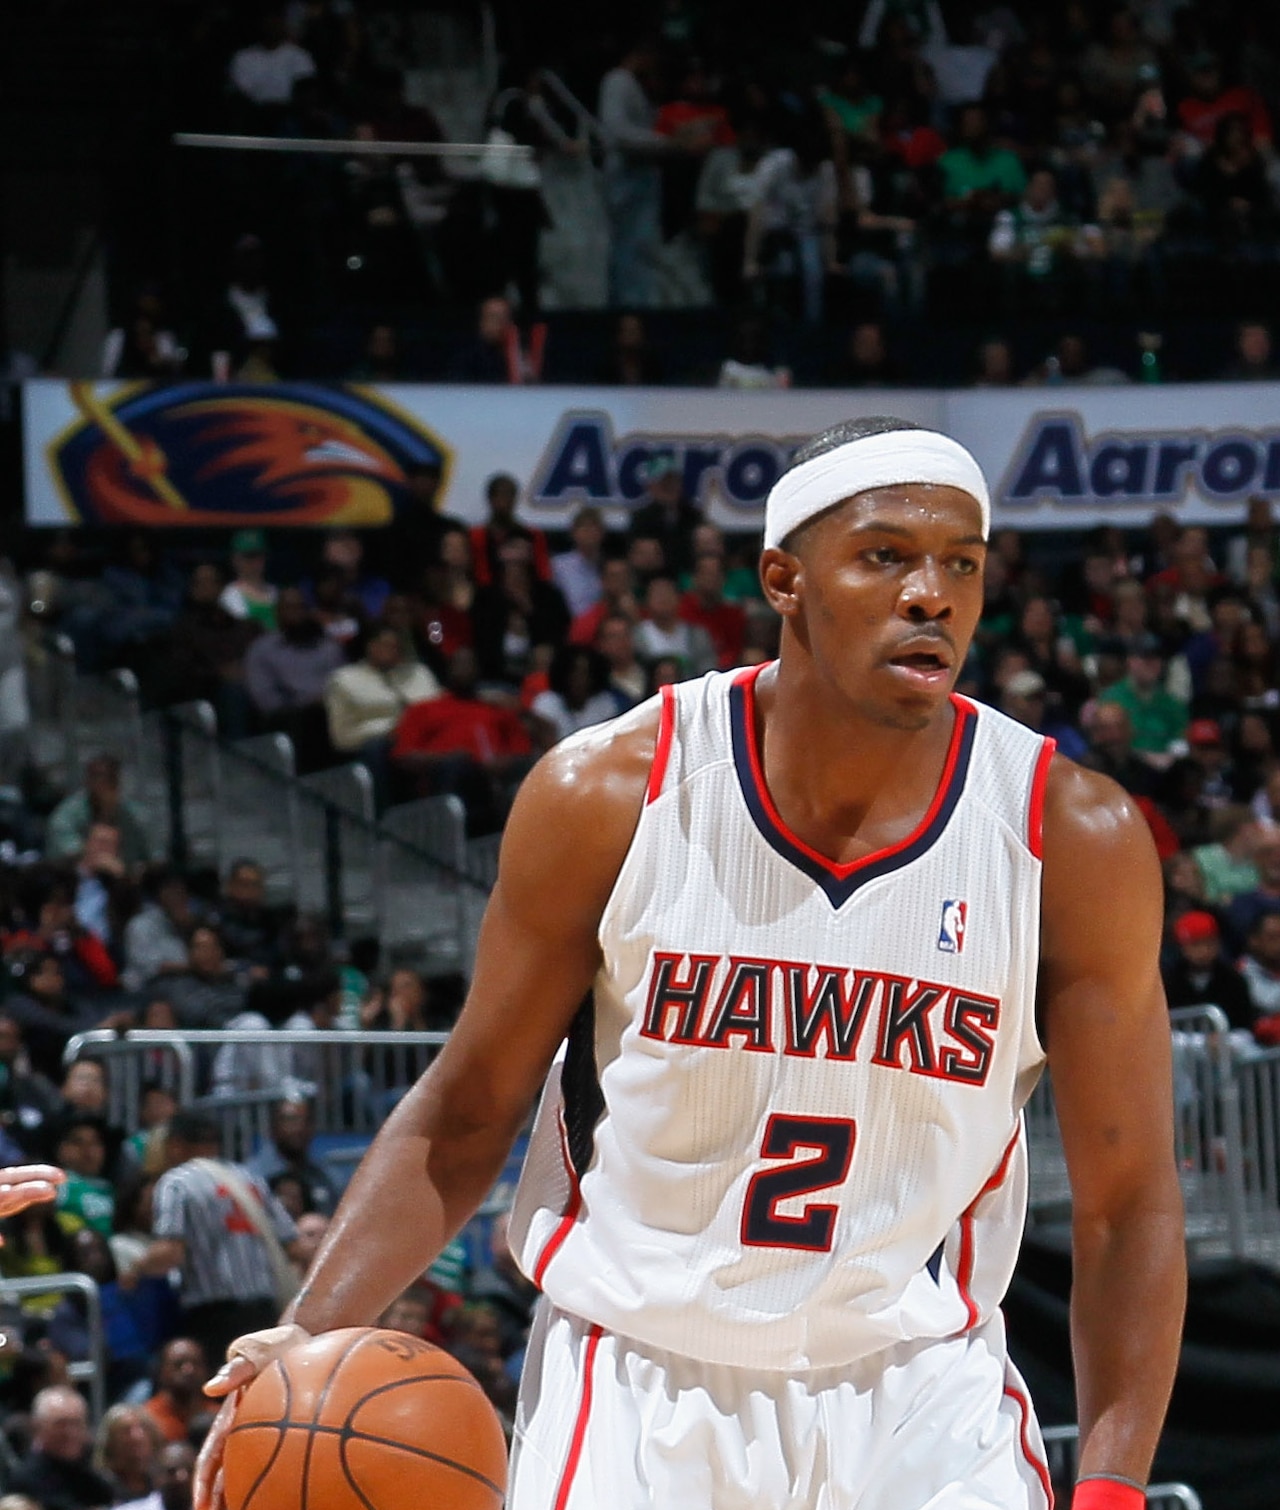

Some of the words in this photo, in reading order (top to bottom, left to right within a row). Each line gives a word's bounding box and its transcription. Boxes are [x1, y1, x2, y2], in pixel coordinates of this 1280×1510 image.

[540, 422, 804, 501] Aaro
[639, 950, 1001, 1087] HAWKS
[740, 1112, 856, 1252] 2
